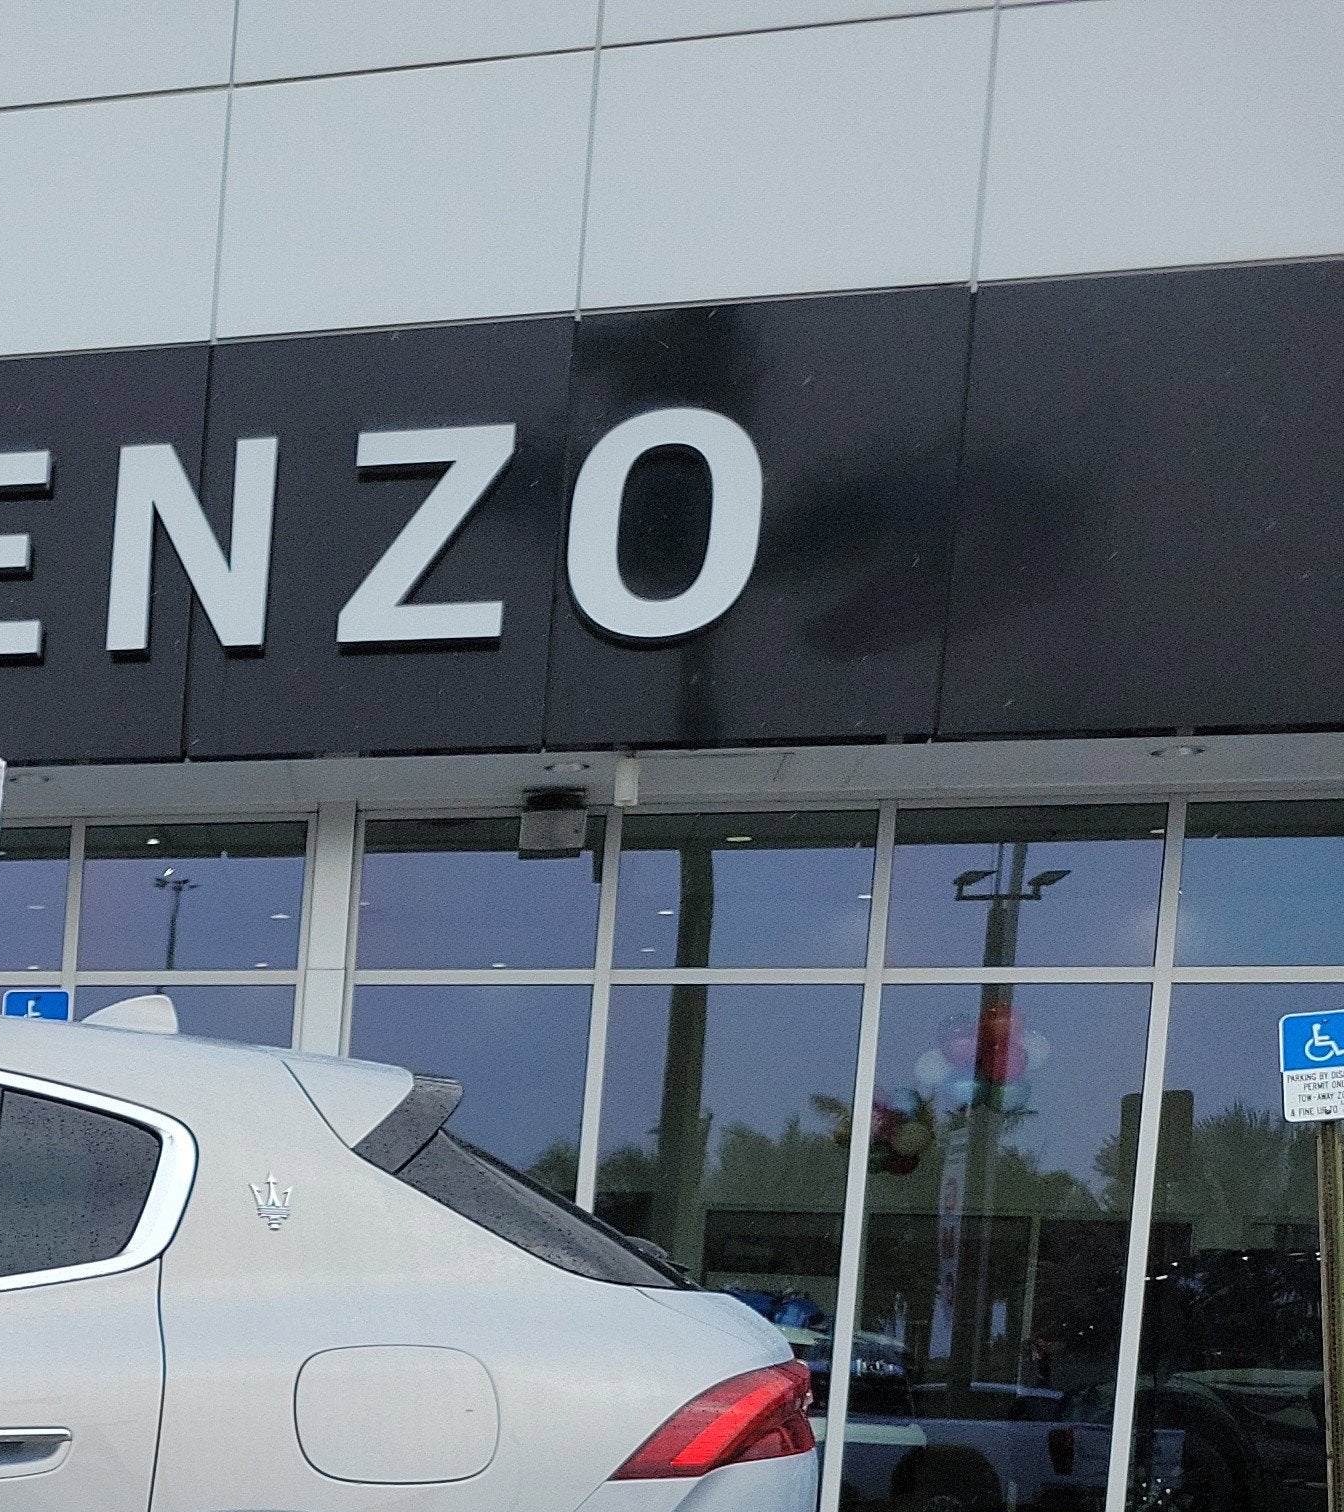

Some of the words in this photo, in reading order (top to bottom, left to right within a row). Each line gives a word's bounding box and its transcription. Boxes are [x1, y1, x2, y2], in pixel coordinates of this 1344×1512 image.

[1287, 1073, 1317, 1083] PARKING
[1319, 1072, 1328, 1080] BY
[1303, 1081, 1329, 1090] PERMIT
[1299, 1107, 1314, 1117] FINE
